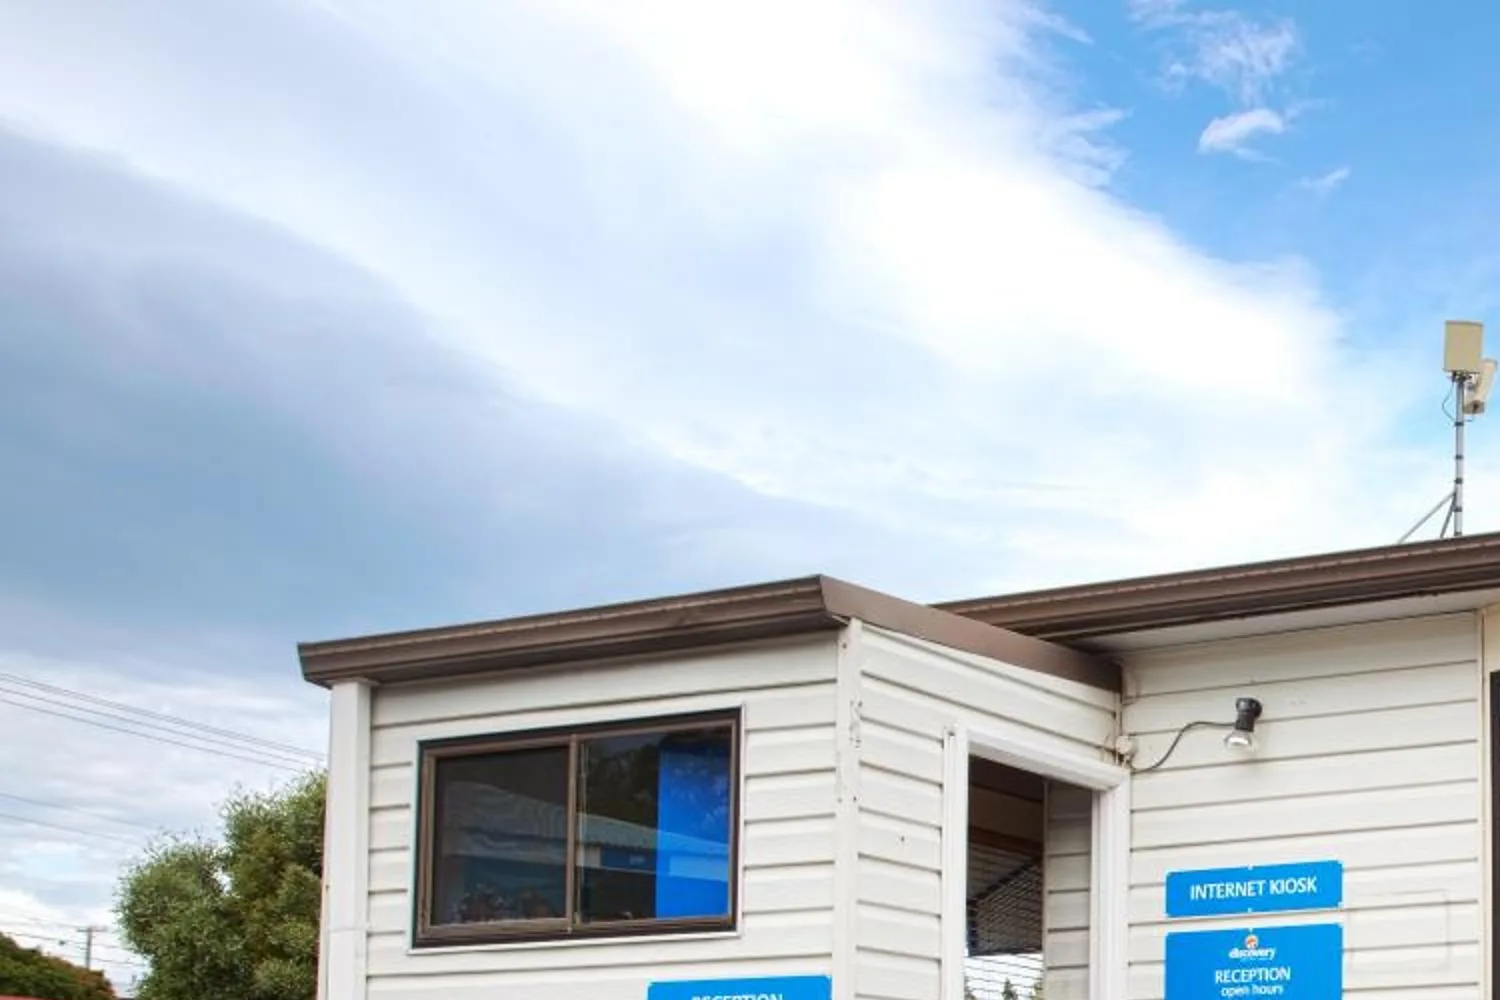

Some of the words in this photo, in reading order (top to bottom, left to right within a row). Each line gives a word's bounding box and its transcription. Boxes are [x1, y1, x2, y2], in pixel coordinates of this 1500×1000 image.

[1190, 880, 1266, 900] INTERNET
[1269, 876, 1317, 895] KIOSK
[1215, 966, 1291, 984] RECEPTION
[1220, 986, 1250, 1000] open
[1252, 984, 1284, 996] hours
